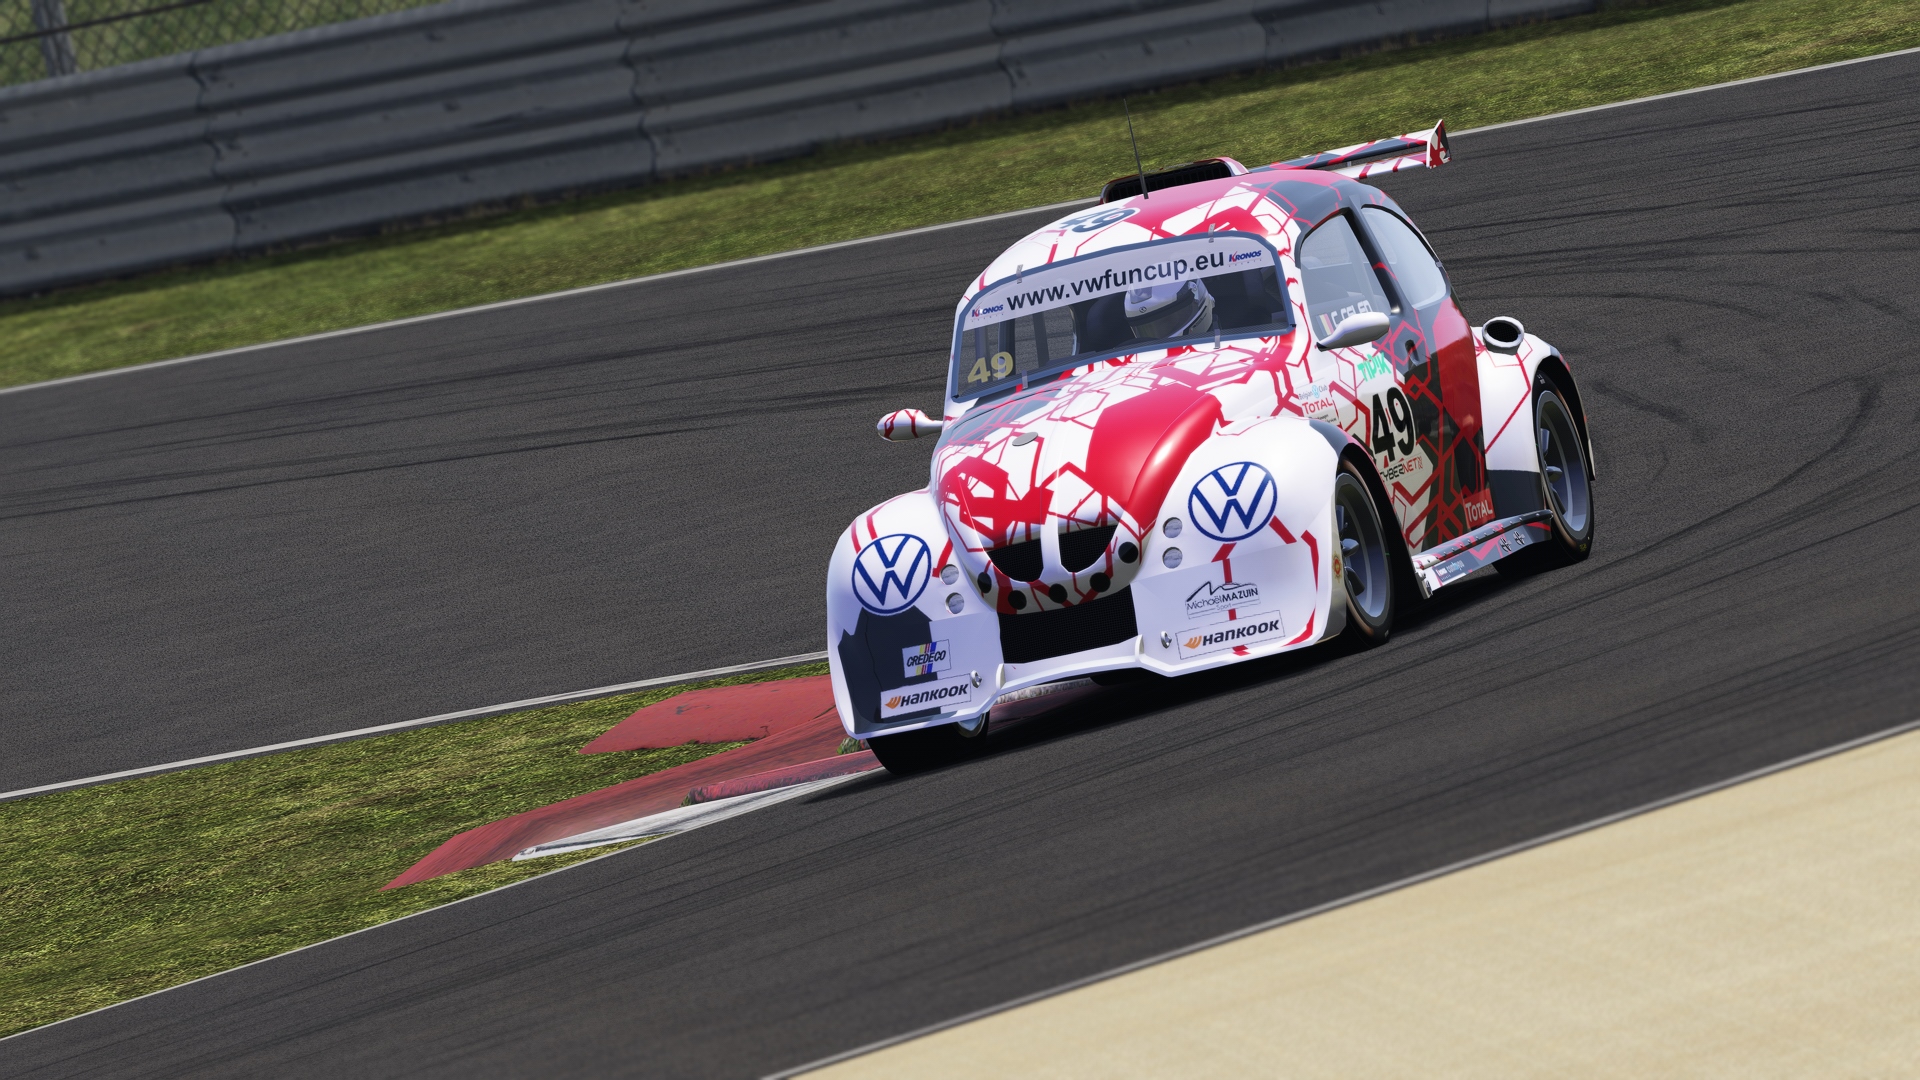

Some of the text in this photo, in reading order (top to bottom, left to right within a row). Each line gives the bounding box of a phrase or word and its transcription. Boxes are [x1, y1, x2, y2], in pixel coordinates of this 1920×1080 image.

[1228, 249, 1262, 263] KRONOS
[1006, 251, 1224, 311] www.vwfuncup.eu
[967, 351, 1014, 383] 49
[1302, 397, 1334, 415] TOTAL
[1372, 386, 1415, 463] 49
[1465, 499, 1493, 523] TOTAL
[906, 650, 947, 668] CREDECO
